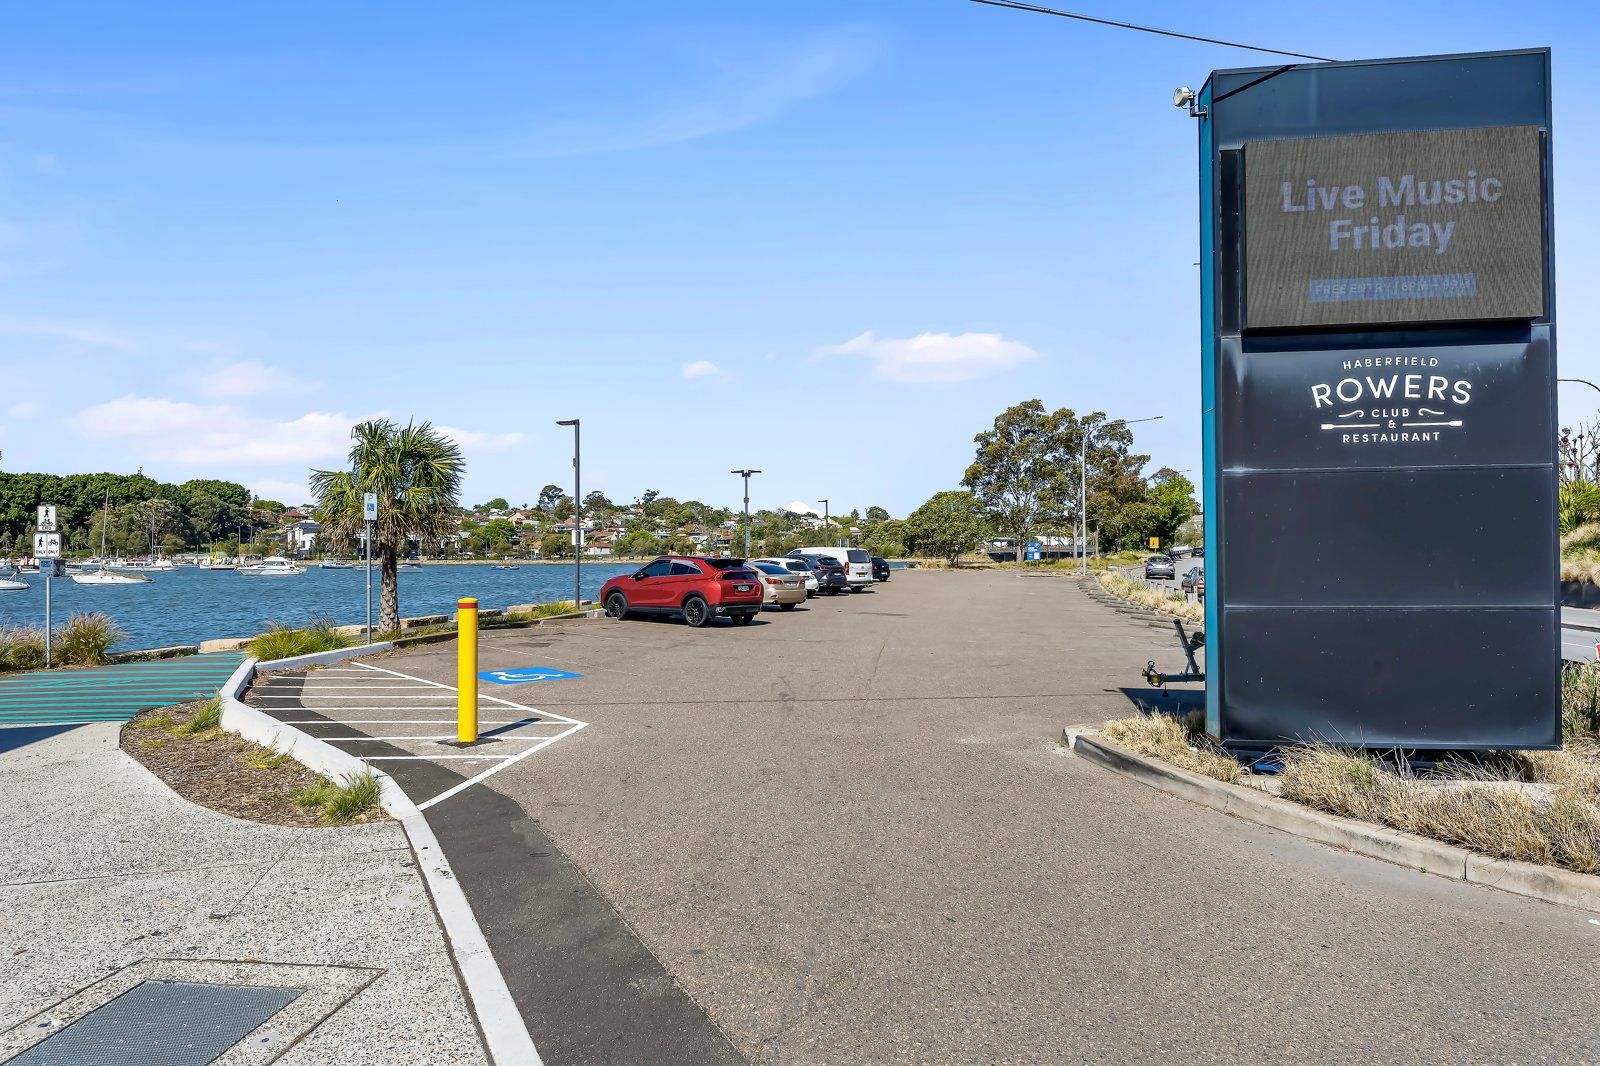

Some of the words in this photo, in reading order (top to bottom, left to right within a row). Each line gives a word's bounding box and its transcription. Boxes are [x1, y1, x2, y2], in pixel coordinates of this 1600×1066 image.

[1282, 179, 1365, 212] Live
[1378, 170, 1502, 207] Music
[1329, 215, 1456, 254] Friday
[1314, 284, 1346, 295] FREE
[1350, 282, 1391, 294] ENTRY
[1343, 356, 1439, 370] HABERFIELD
[1311, 374, 1472, 408] ROWERS
[1371, 408, 1410, 418] CLUB
[1388, 419, 1397, 429] &
[1343, 431, 1440, 443] RESTAURANT
